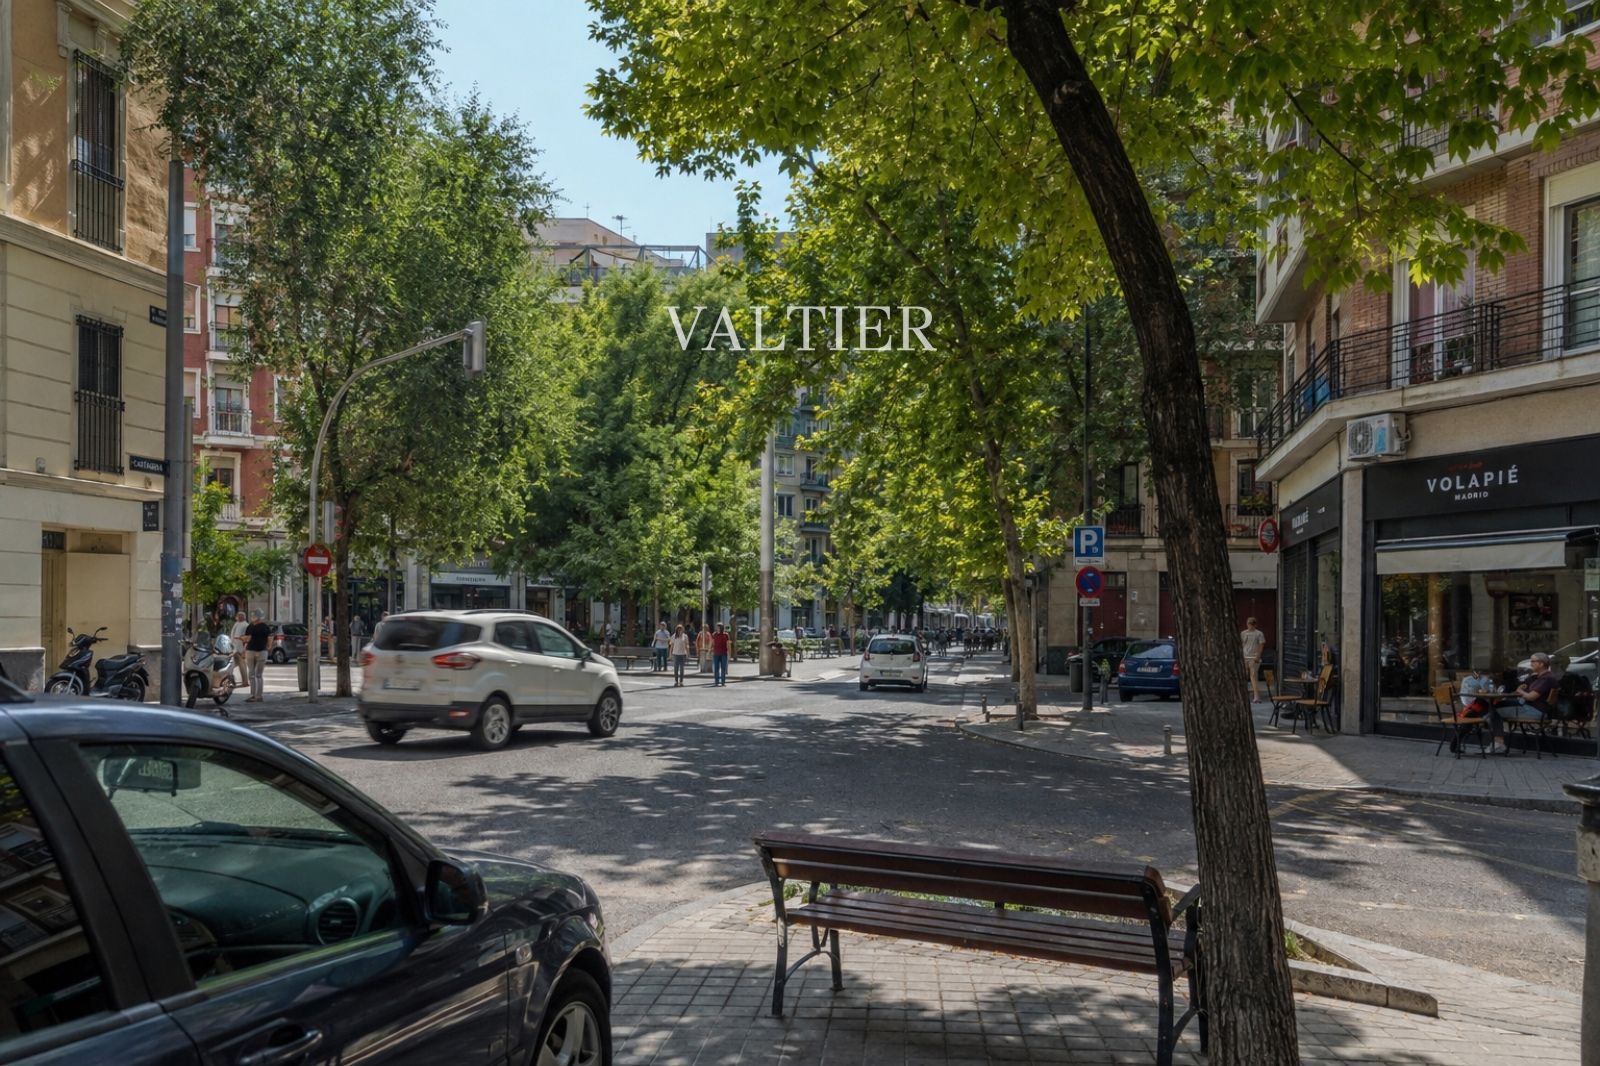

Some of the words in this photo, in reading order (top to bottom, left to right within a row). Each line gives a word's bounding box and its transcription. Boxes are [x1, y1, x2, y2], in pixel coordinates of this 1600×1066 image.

[1427, 464, 1518, 493] VOLAPIÉ
[1454, 491, 1489, 500] MADRID
[1080, 529, 1098, 554] P
